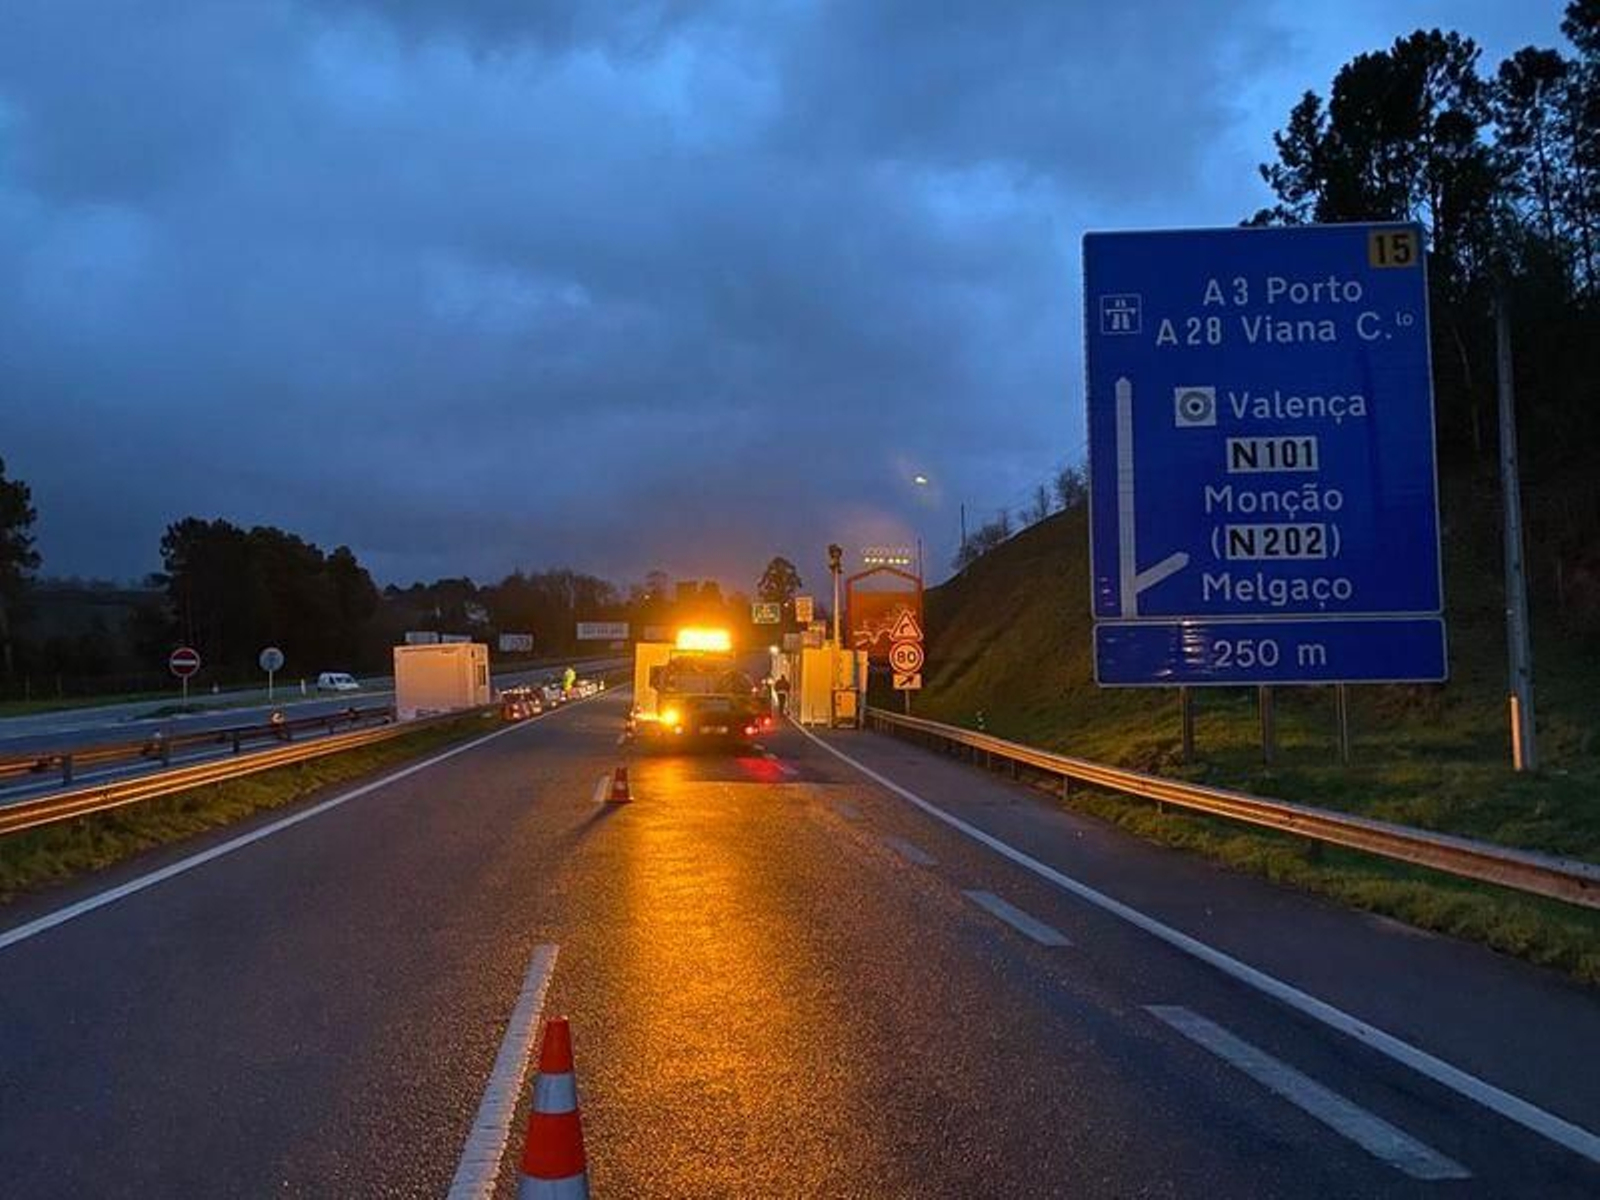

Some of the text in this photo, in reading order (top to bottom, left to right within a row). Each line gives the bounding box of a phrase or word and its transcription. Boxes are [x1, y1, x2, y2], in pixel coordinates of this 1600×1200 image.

[1374, 234, 1411, 265] 15
[1267, 275, 1363, 305] Porto
[1241, 314, 1337, 343] Viana
[1229, 390, 1368, 425] Valença
[1231, 439, 1313, 469] N101
[1204, 483, 1343, 520] Monção
[1202, 571, 1352, 609] Melgaço
[897, 651, 916, 664] 80
[1213, 639, 1327, 668] 250 m
